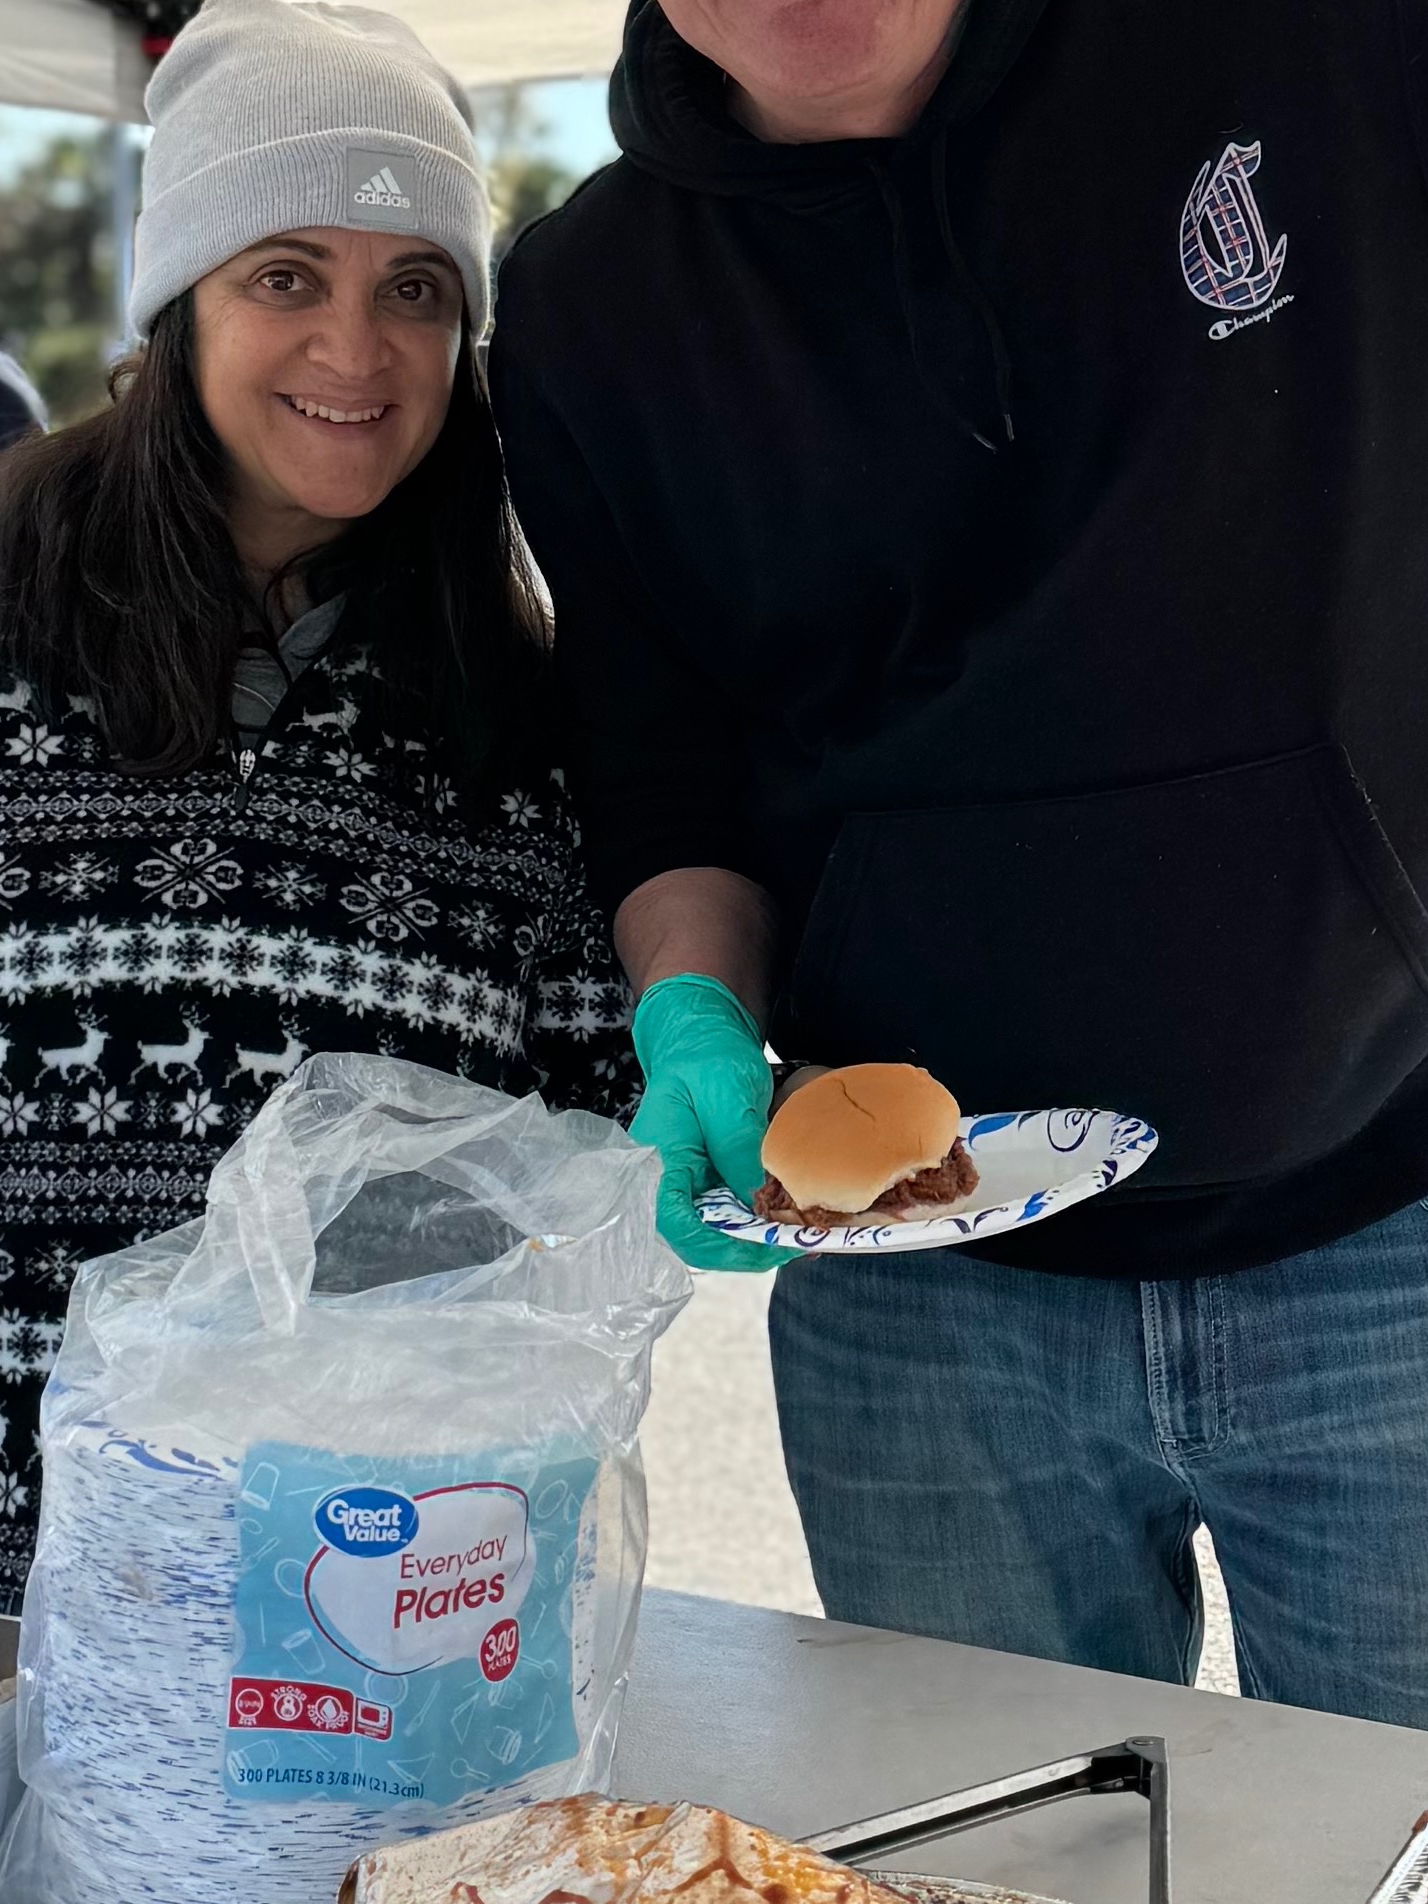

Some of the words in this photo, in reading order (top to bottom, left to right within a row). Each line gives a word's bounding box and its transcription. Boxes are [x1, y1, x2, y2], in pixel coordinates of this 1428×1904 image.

[354, 190, 411, 209] adidas
[1208, 294, 1295, 340] Champion
[327, 1498, 402, 1527] Great
[343, 1524, 401, 1542] Value
[400, 1534, 508, 1580] Everyday
[393, 1572, 506, 1629] Plates
[484, 1625, 517, 1663] 300
[238, 1768, 263, 1783] 300
[266, 1768, 313, 1784] PLATES
[315, 1771, 325, 1785] 8
[327, 1771, 350, 1786] 3/8
[352, 1773, 367, 1788] IN
[369, 1777, 425, 1799] (21.3cm)
